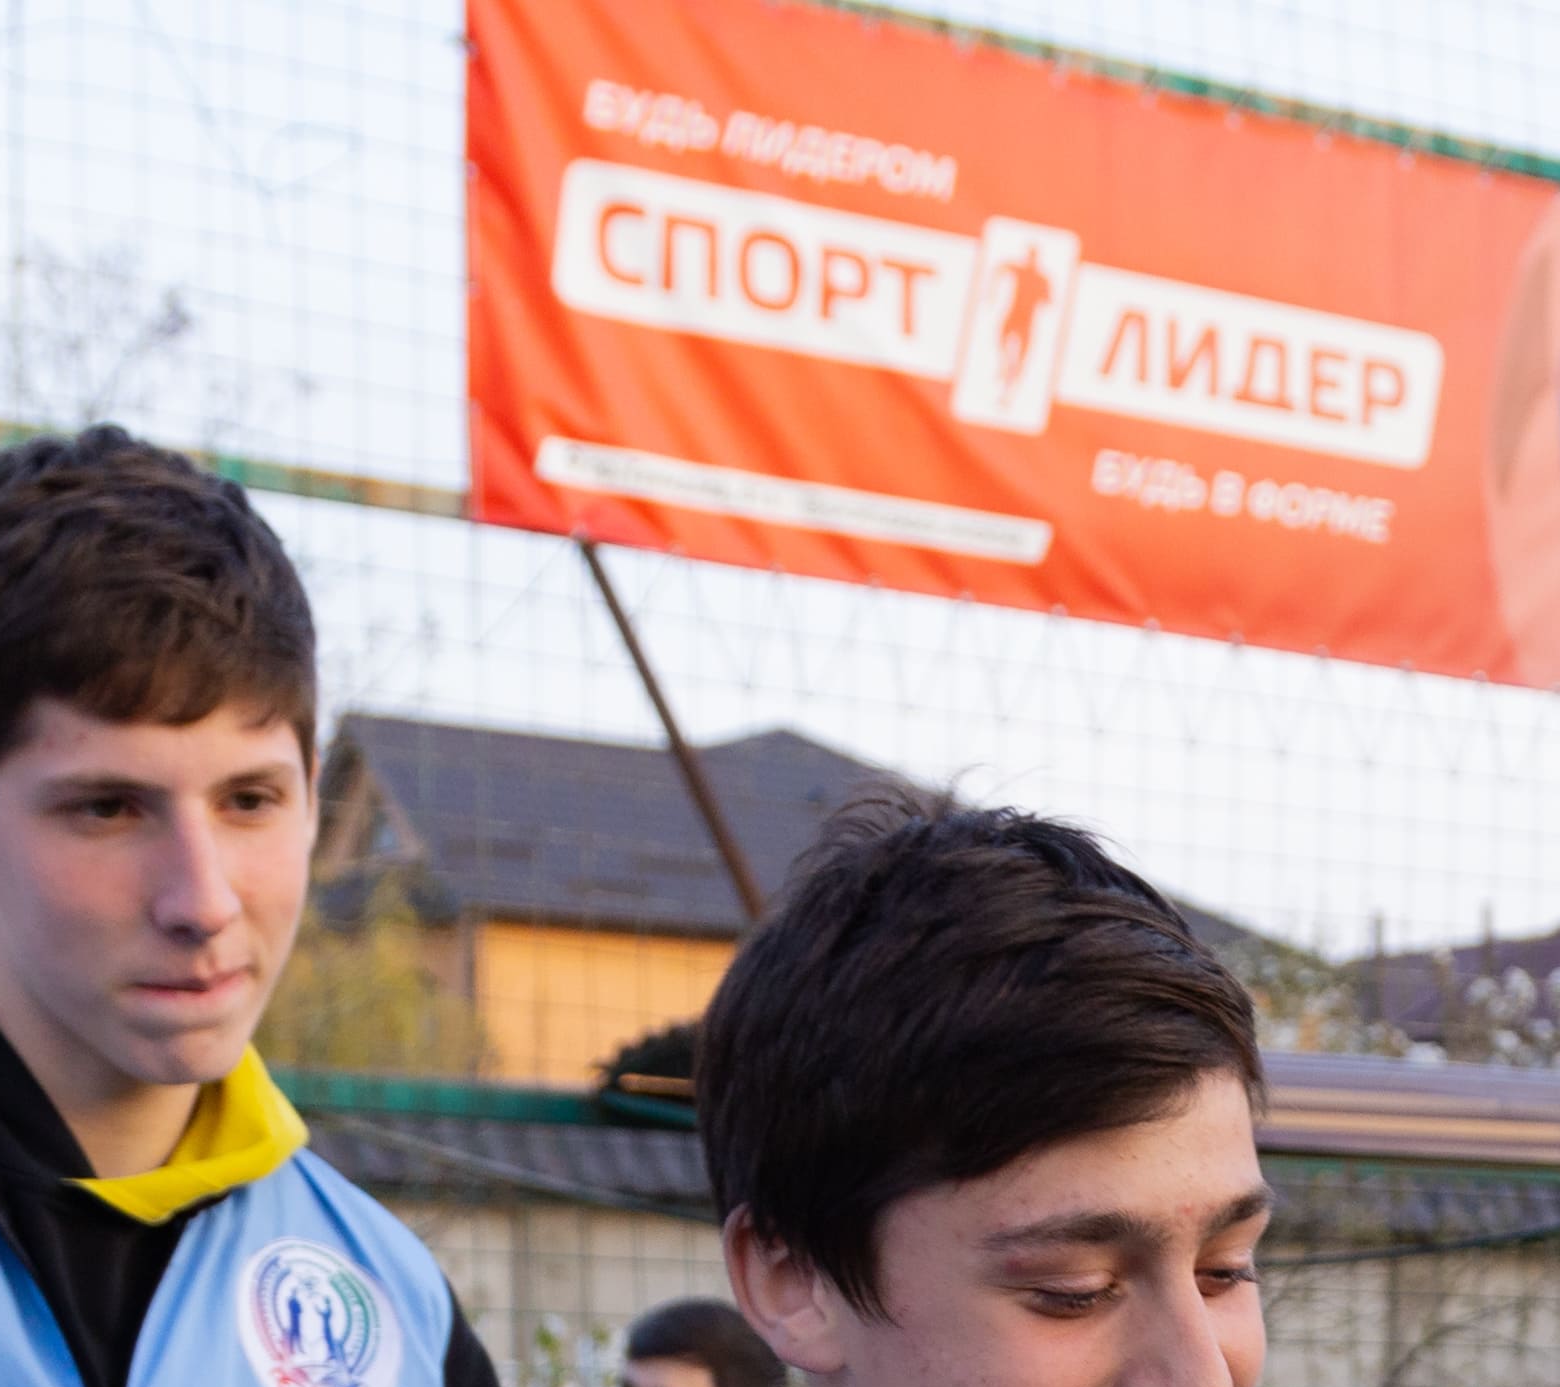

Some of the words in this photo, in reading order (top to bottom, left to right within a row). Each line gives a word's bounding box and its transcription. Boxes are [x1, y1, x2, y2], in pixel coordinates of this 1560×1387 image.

[585, 79, 718, 152] БУДЬ
[722, 111, 956, 201] ЛИДЕРОМ
[598, 202, 936, 336] СПОРТ
[1100, 310, 1405, 427] ЛИДЕР
[1092, 449, 1207, 513] БУДЬ
[1209, 471, 1244, 517] В
[1247, 479, 1395, 543] ФОРМЕ
